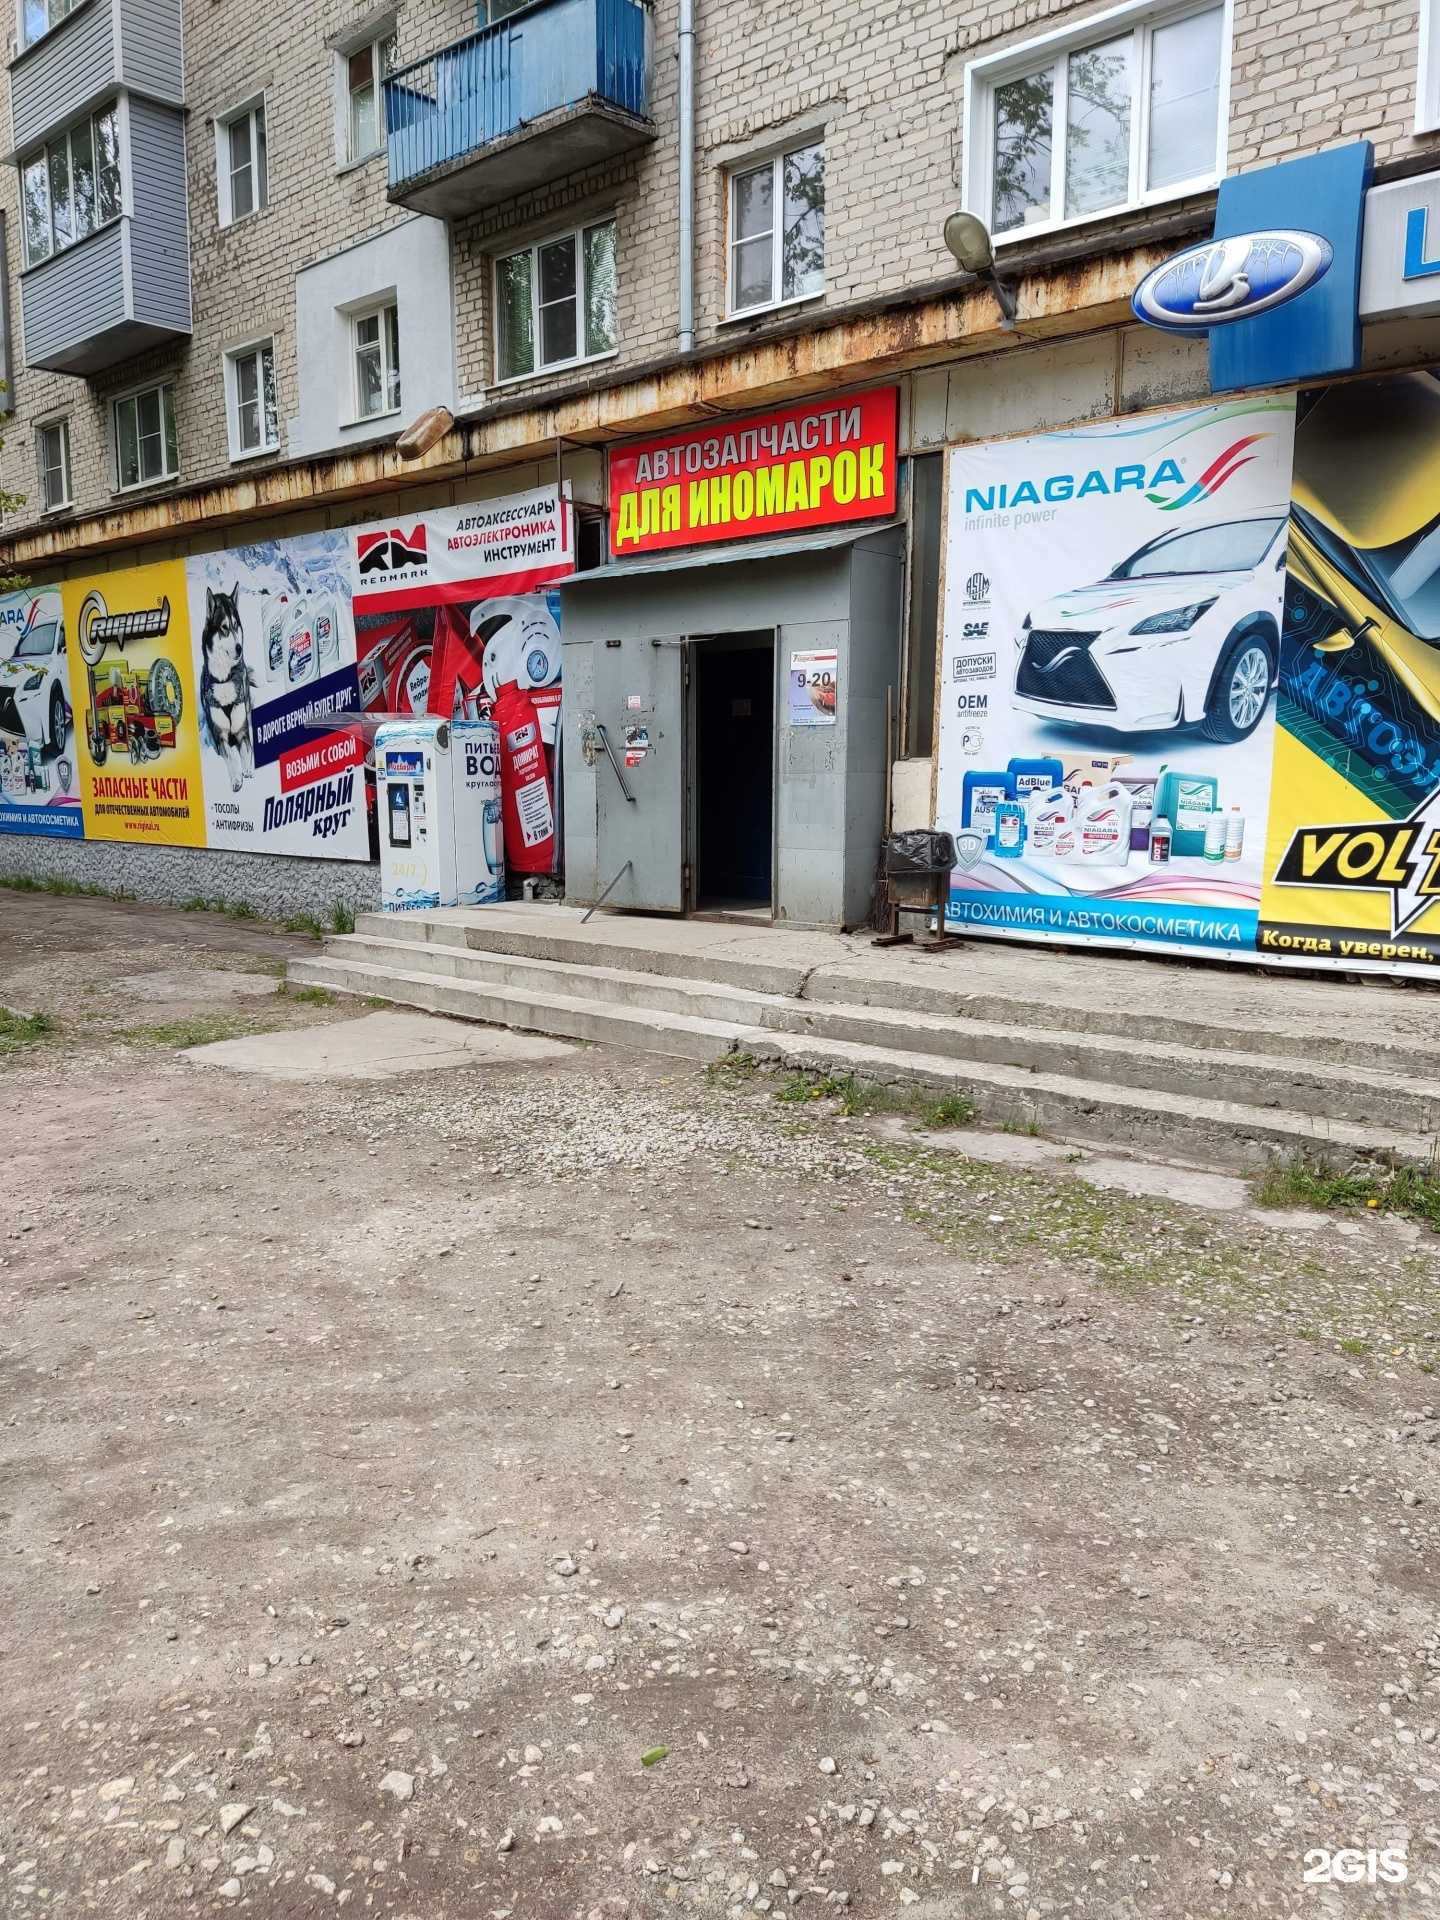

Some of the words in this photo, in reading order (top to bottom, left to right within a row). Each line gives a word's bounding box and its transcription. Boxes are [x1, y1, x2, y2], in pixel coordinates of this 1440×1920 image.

[635, 406, 861, 484] АВТОЗАПЧАСТИ
[616, 483, 681, 547] ДЛЯ
[690, 442, 885, 528] ИНОМАРОК
[966, 458, 1185, 512] NIAGARA
[456, 499, 555, 531] АВТОАКСЕССУАРЫ
[964, 514, 1010, 531] infinite
[1013, 508, 1057, 529] power
[448, 519, 555, 551] АВТОЭЛЕКТРОНИКА
[484, 537, 556, 563] ИНСТРУМЕНТ
[963, 622, 989, 637] SAE
[956, 656, 993, 668] ДОПУСКИ
[798, 672, 830, 688] 9-20
[958, 694, 988, 709] OEM
[263, 716, 286, 744] ДОРОГЕ
[286, 700, 313, 734] ВЕРНЫЙ
[314, 694, 335, 719] БУДЕТ
[335, 686, 352, 714] ДРУГ
[286, 752, 319, 780] ВОЗЬМИ
[321, 751, 327, 765] С
[328, 735, 357, 763] СОБОЙ
[92, 776, 149, 799] ЗАПАСНЫЕ
[151, 778, 188, 800] ЧАСТИ
[1018, 777, 1051, 787] AdBlue
[28, 813, 80, 826] АВТОКОСМЕТИКА
[95, 804, 105, 816] ДЛЯ
[106, 804, 149, 817] ОТЕЧЕСТВЕННЫХ
[150, 805, 190, 819] АВТОМОБИЛЕЙ
[214, 803, 240, 814] ТОСОЛЫ
[216, 820, 254, 831] АНТИФРИЗЫ
[312, 808, 351, 838] круг
[961, 839, 976, 850] 3D
[1050, 911, 1062, 926] И
[1066, 912, 1241, 942] АВТОКОСМЕТИКА
[1262, 930, 1331, 952] Когда
[1339, 939, 1434, 961] уверен,
